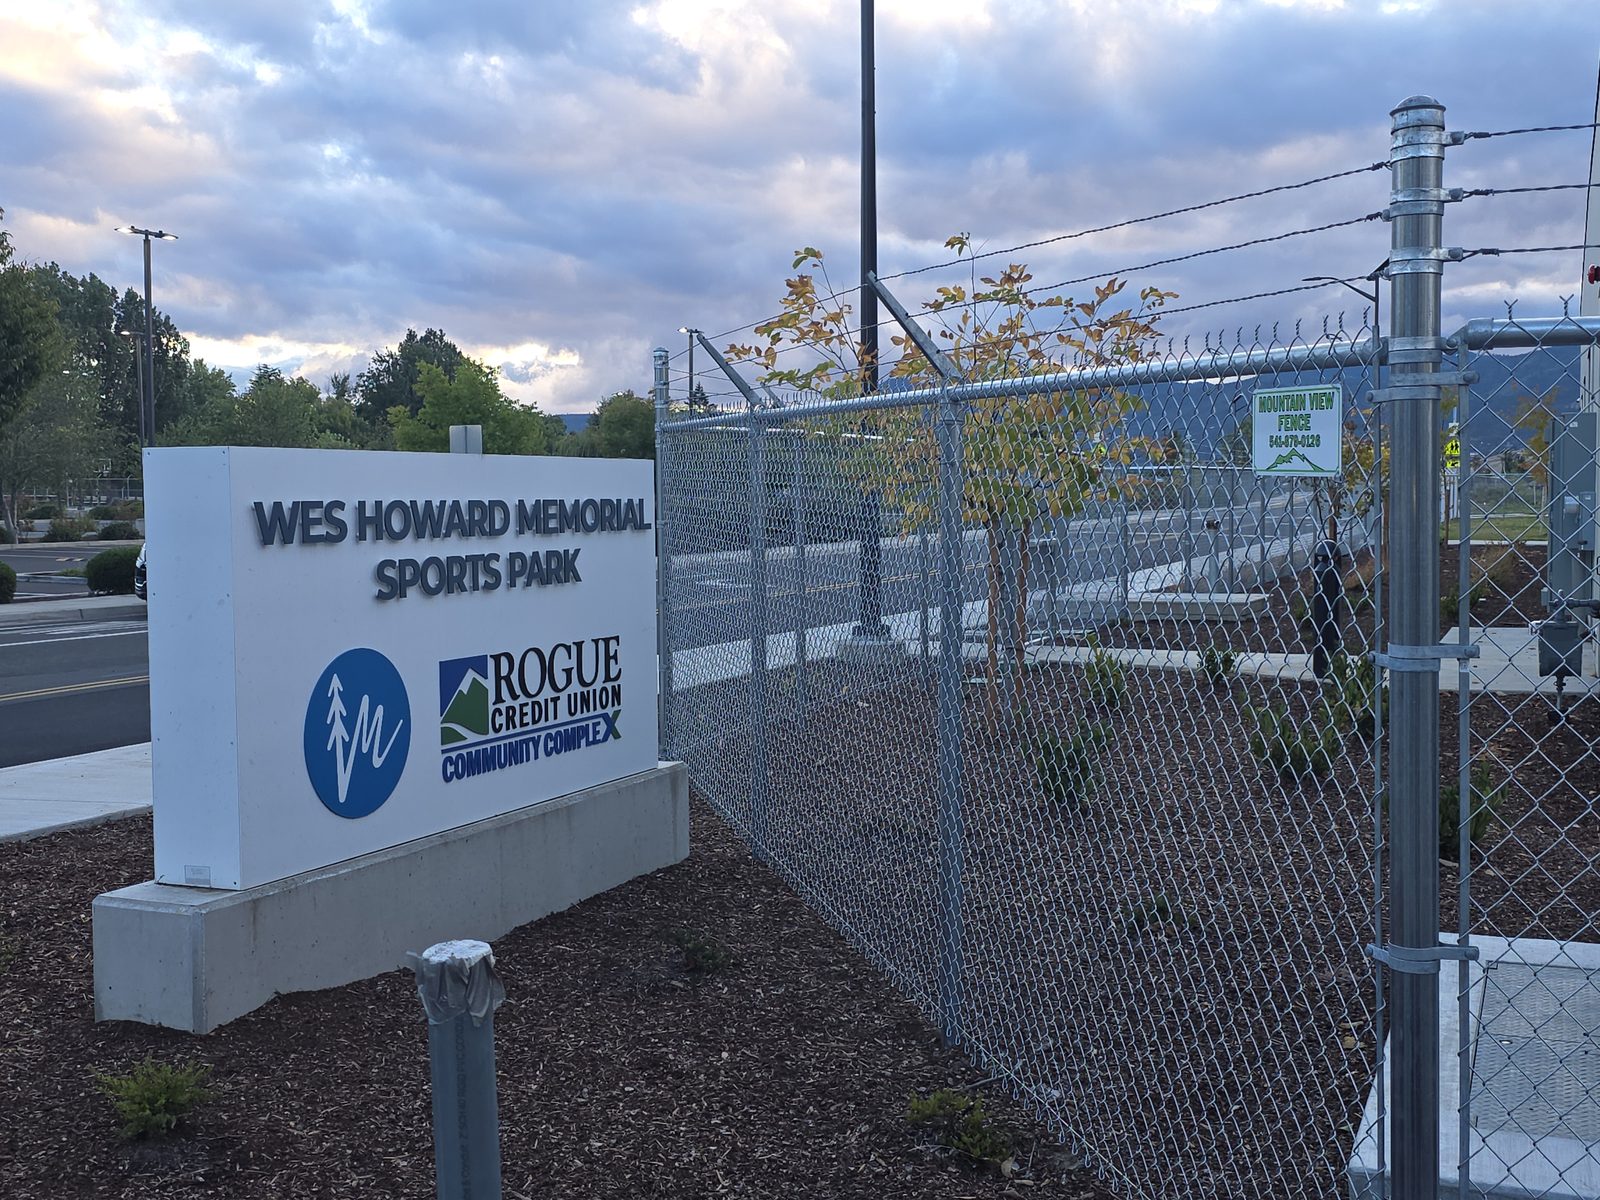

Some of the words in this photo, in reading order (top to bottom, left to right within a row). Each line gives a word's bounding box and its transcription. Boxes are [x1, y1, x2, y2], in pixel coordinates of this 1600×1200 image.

[1259, 394, 1306, 413] MOUNTAIN
[1309, 391, 1334, 411] VIEW
[1278, 413, 1311, 432] FENCE
[253, 499, 348, 545] WES
[357, 498, 511, 542] HOWARD
[517, 498, 652, 536] MEMORIAL
[376, 552, 502, 601] SPORTS
[508, 548, 582, 589] PARK
[490, 635, 622, 704] ROGUE
[491, 696, 560, 734] CREDIT
[567, 684, 622, 716] UNION
[442, 738, 541, 784] COMMUNITY
[543, 709, 622, 757] COMPLEX
